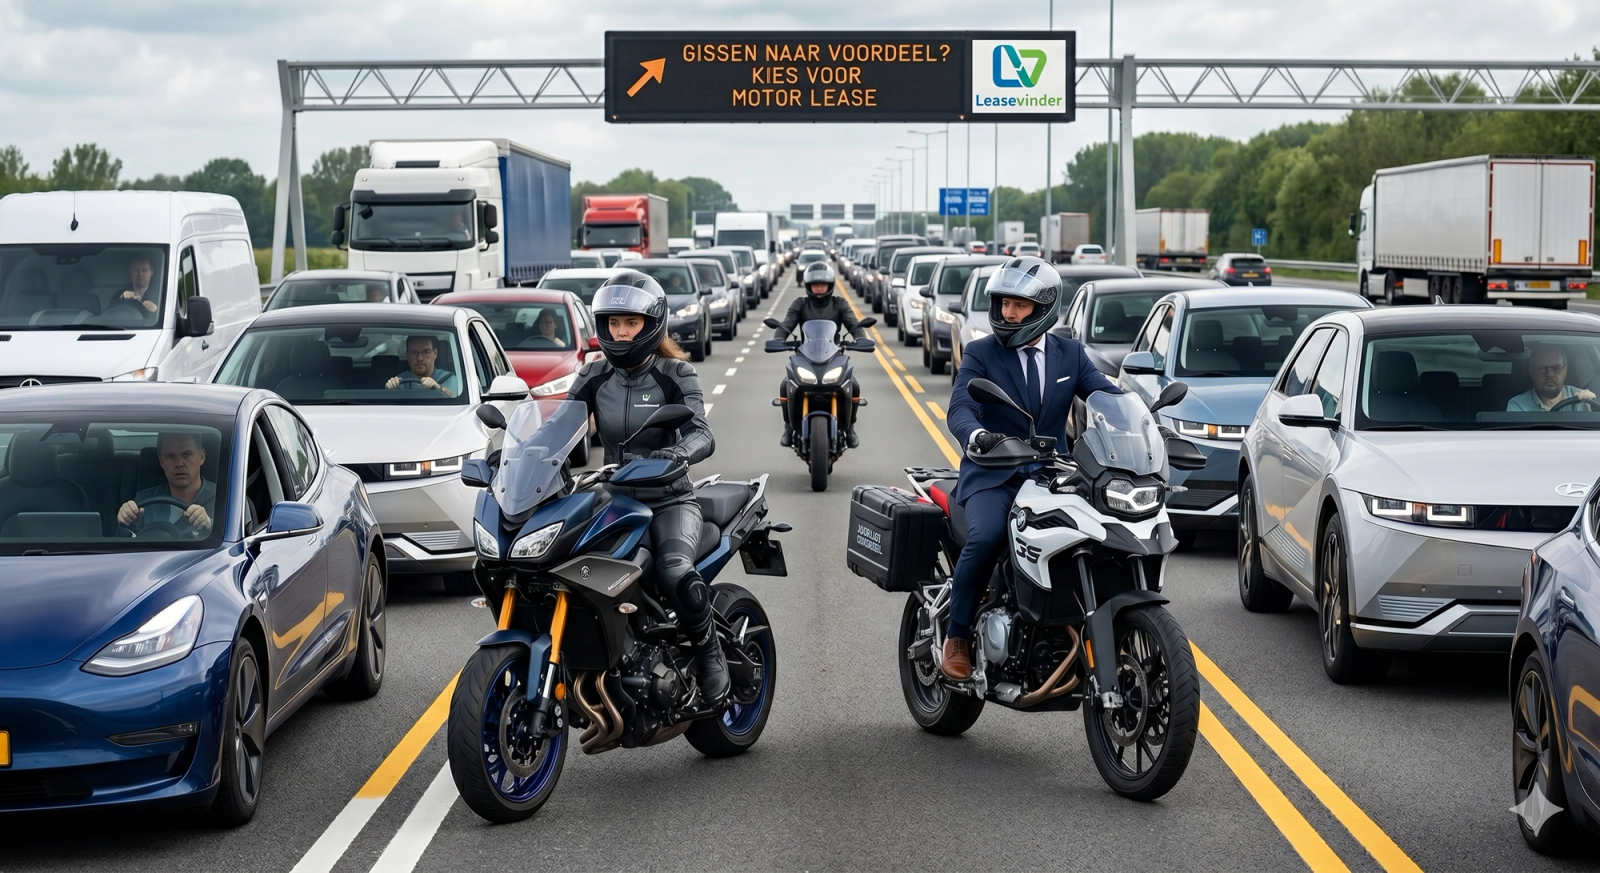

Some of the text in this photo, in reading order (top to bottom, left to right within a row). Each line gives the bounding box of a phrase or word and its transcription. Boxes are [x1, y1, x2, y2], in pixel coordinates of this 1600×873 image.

[682, 44, 951, 62] GISSEN NAAR VOORDEEL?
[752, 66, 861, 84] KIES VOOR
[732, 89, 877, 107] MOTOR LEASE
[976, 94, 1062, 107] Leasevinder
